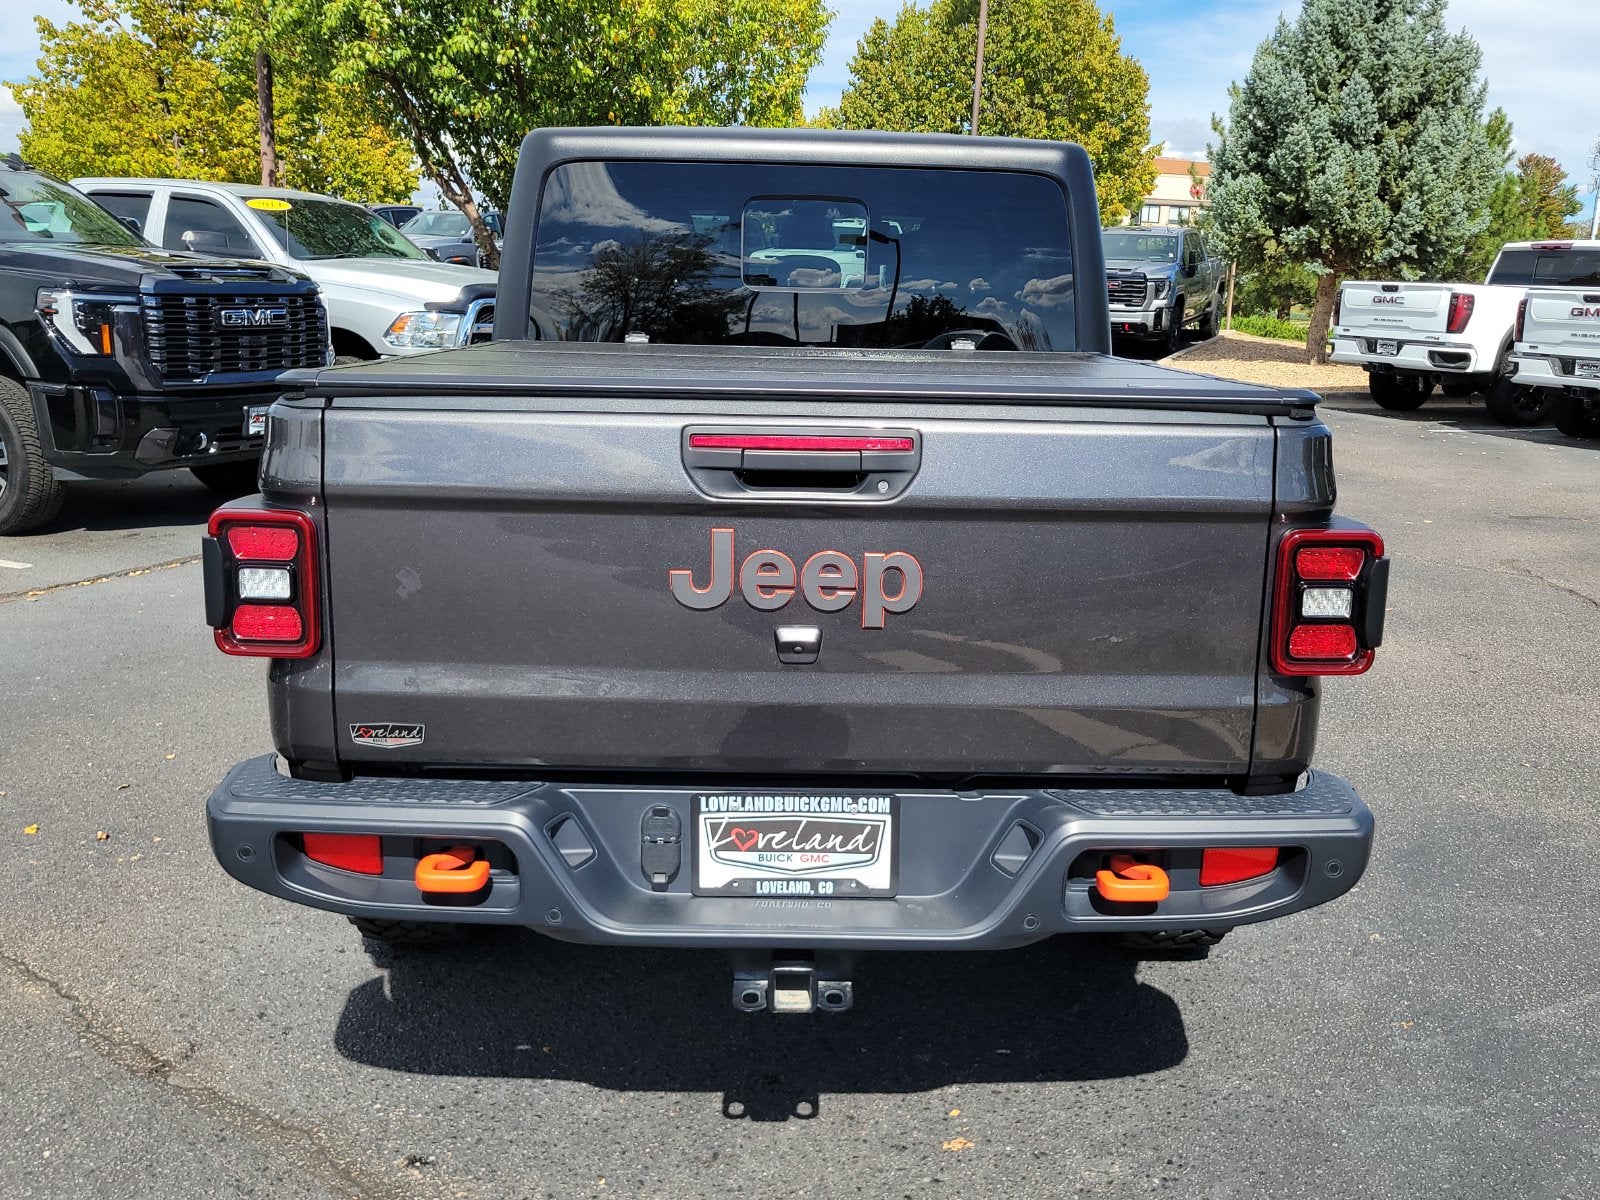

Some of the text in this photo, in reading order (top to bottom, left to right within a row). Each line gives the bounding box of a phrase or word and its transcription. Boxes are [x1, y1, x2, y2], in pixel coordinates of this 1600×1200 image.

[1372, 295, 1405, 305] GMC
[220, 308, 287, 326] GMC
[1570, 307, 1600, 317] GM
[669, 528, 924, 630] Jeep
[700, 796, 890, 813] LOVELANDBUICKGMCCOM
[758, 853, 830, 863] BUICK GMC
[756, 880, 834, 895] LOVELAND, CO
